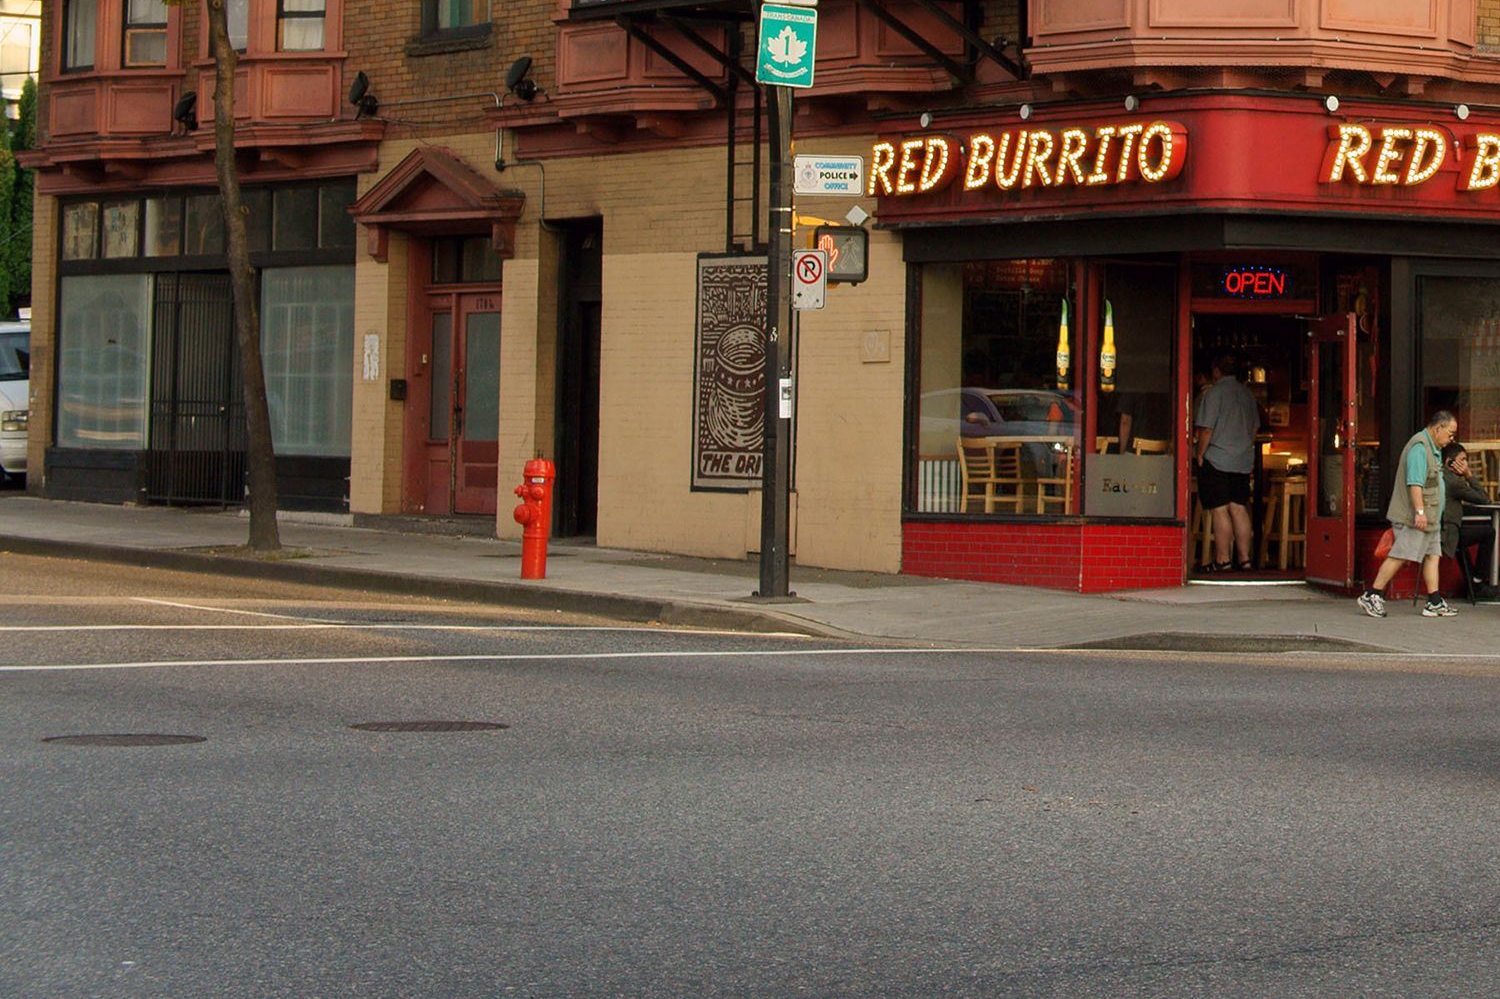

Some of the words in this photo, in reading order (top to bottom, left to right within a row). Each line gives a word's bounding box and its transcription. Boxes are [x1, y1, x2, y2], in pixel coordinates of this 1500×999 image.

[784, 35, 790, 56] 1
[867, 135, 951, 196] RED
[963, 121, 1174, 191] BURRITO
[1326, 124, 1446, 185] RED
[820, 171, 847, 180] POLICE
[824, 182, 848, 190] OFFICE
[1226, 272, 1285, 294] OPEN
[702, 454, 729, 472] THE
[735, 455, 762, 473] DRI
